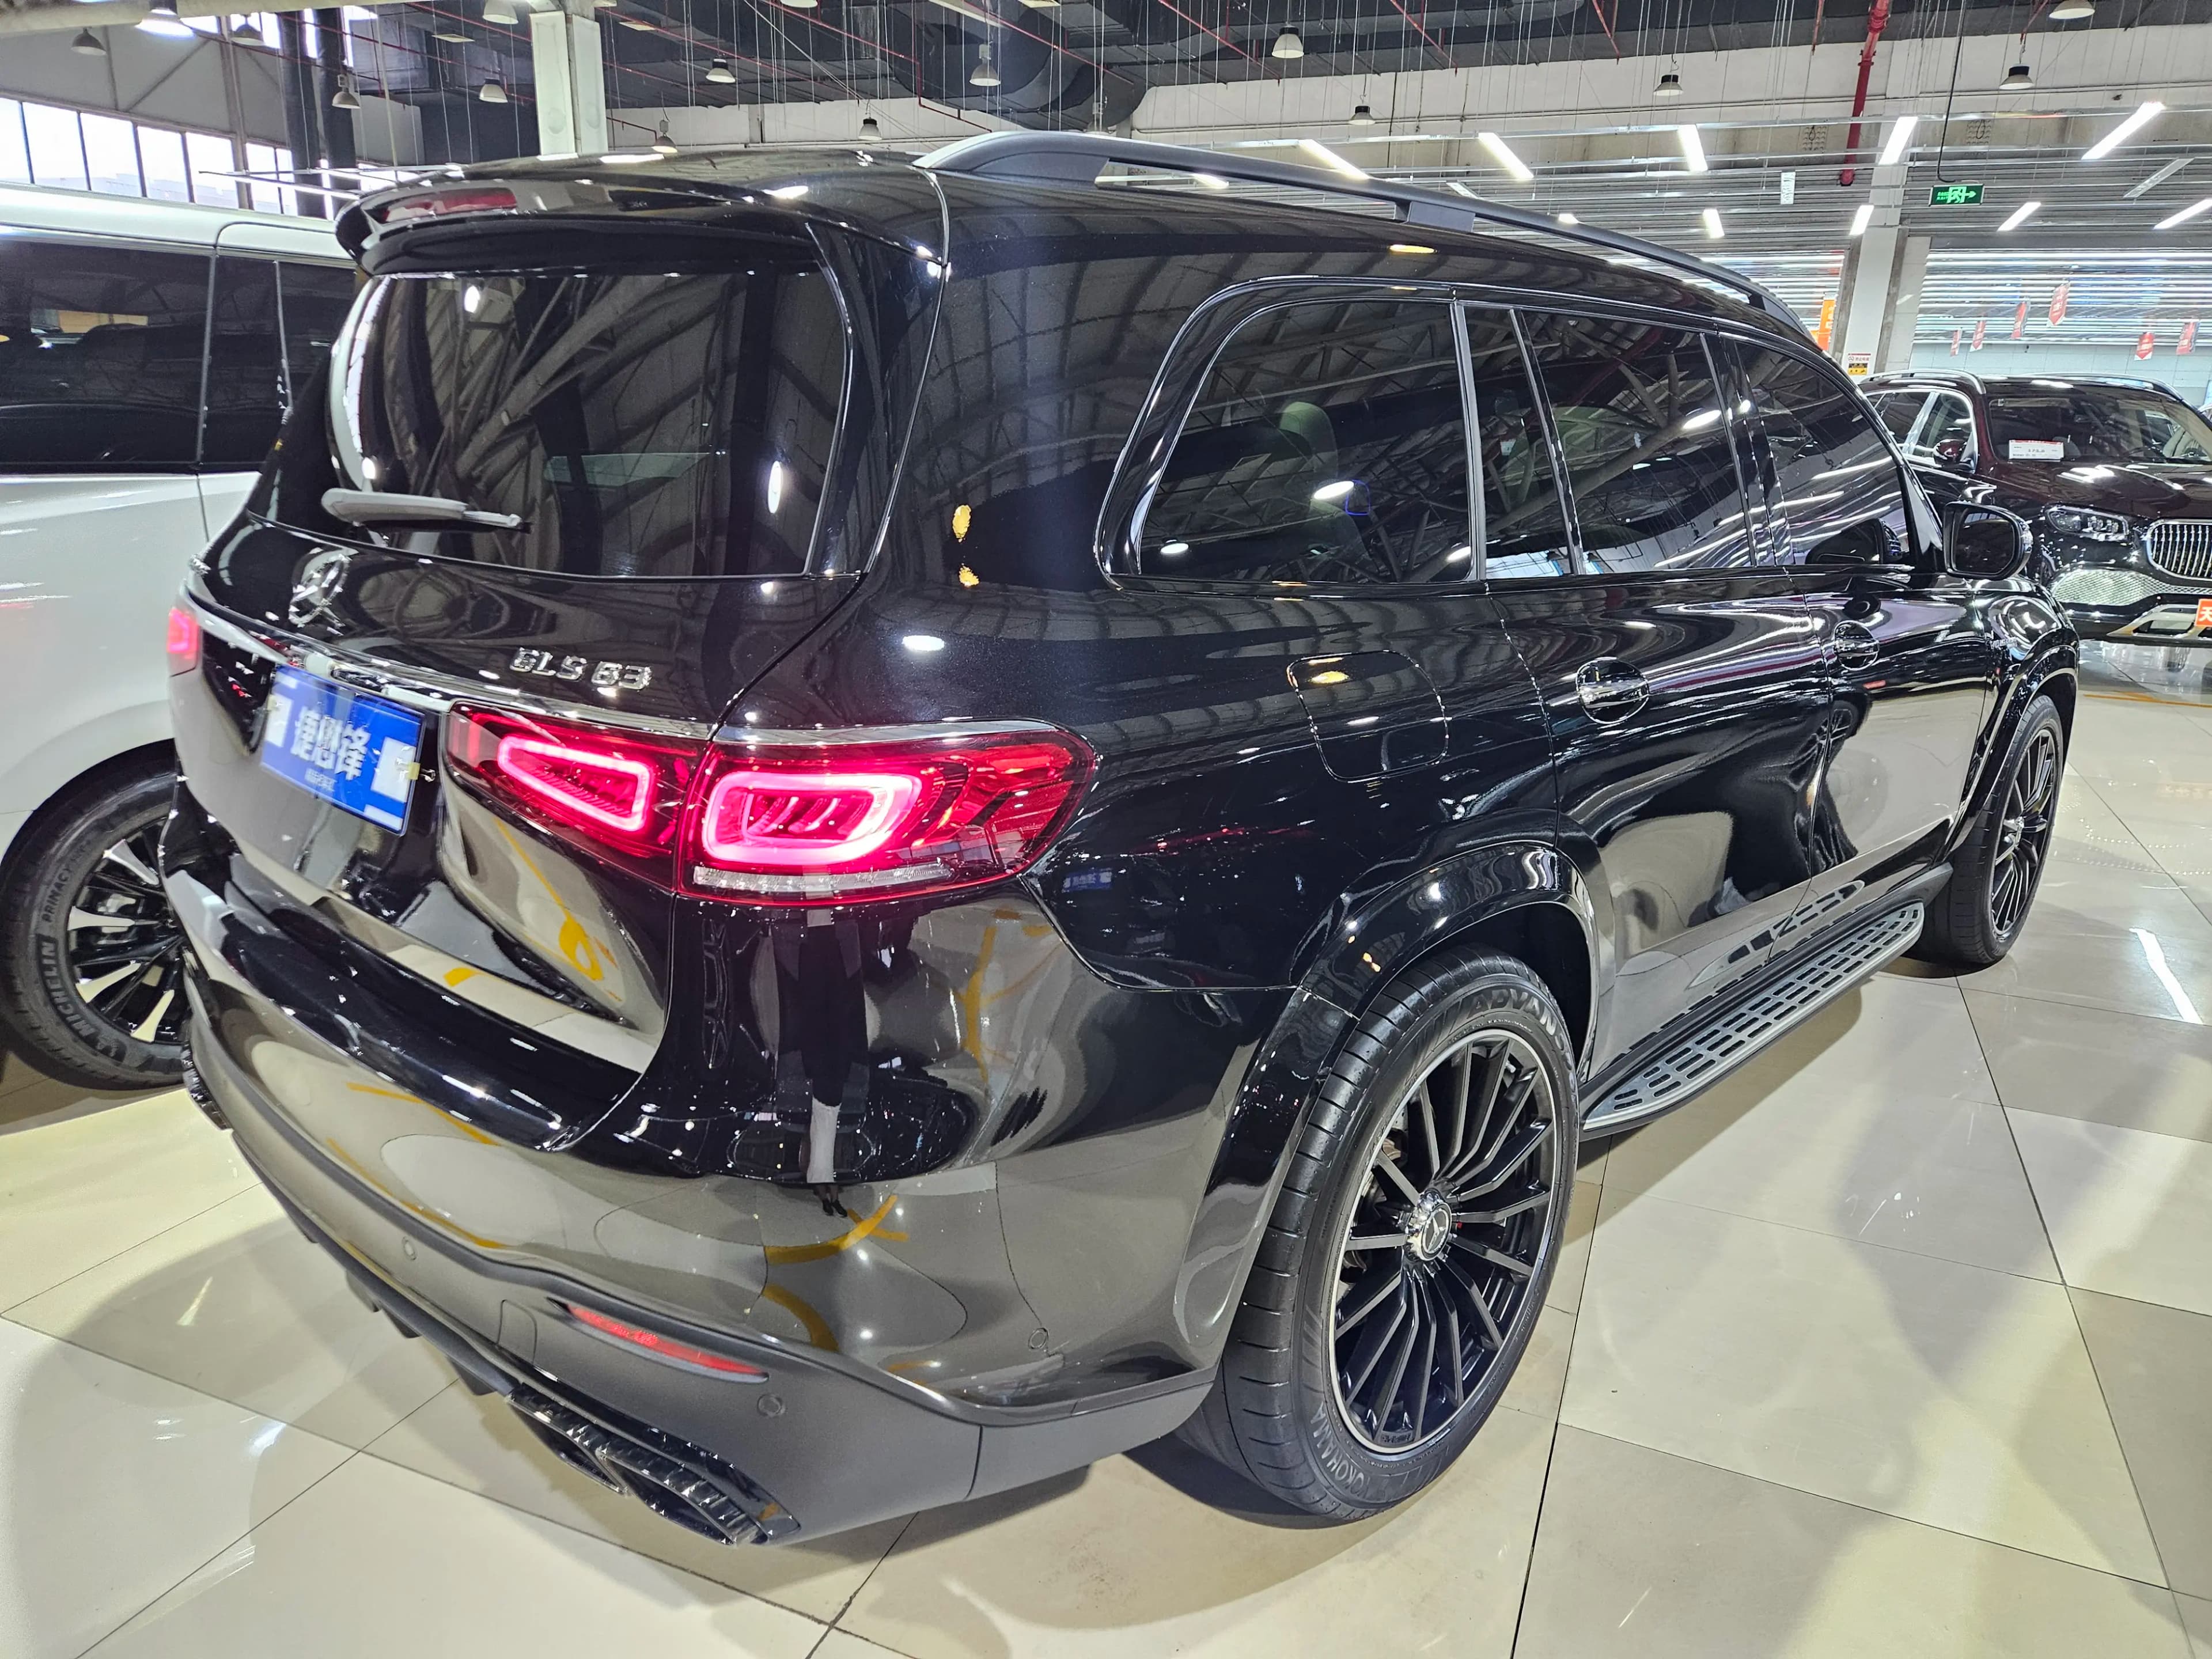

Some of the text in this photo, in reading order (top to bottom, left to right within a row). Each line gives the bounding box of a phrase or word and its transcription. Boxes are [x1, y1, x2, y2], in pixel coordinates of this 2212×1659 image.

[510, 647, 652, 690] GLS 63
[40, 940, 97, 1037] MICHELIN
[1467, 988, 1556, 1036] ADVAN
[1310, 1401, 1371, 1499] YOKOHAMA
